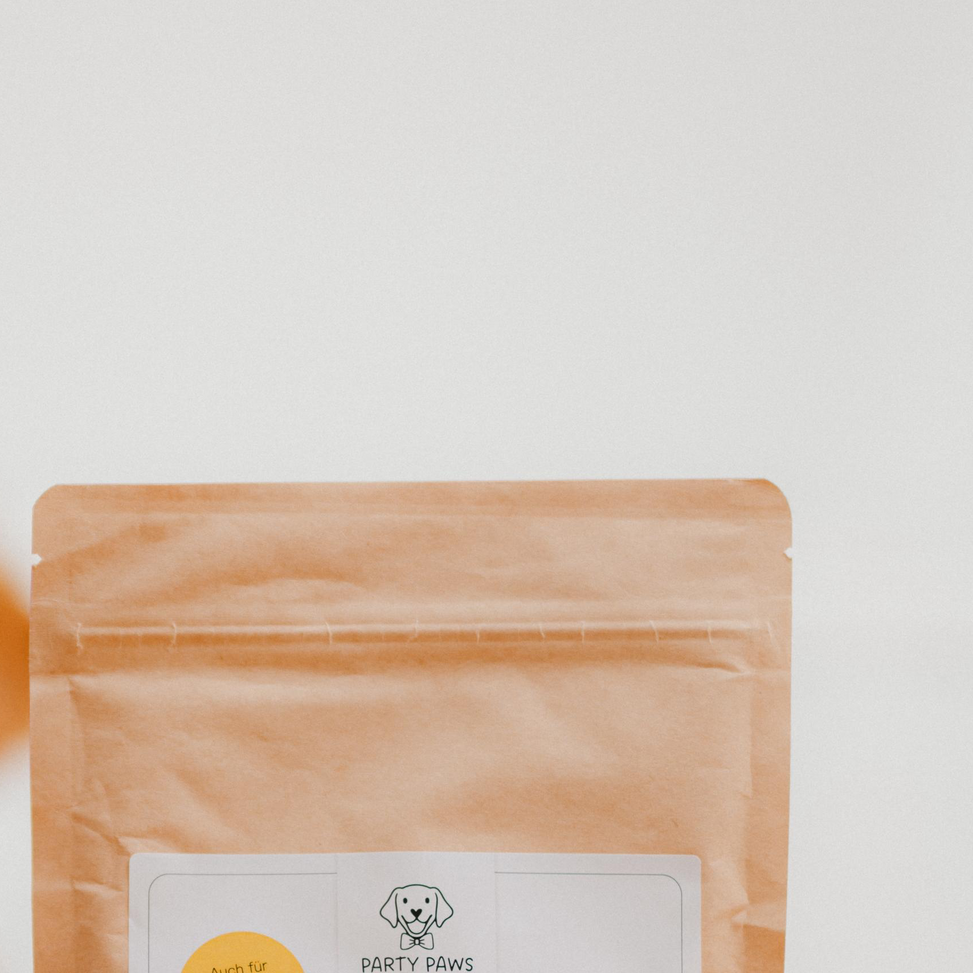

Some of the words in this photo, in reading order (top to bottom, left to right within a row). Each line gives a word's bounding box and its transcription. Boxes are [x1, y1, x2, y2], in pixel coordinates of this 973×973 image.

[248, 961, 267, 973] für
[361, 956, 419, 973] PARTY
[426, 956, 474, 972] PAWS
